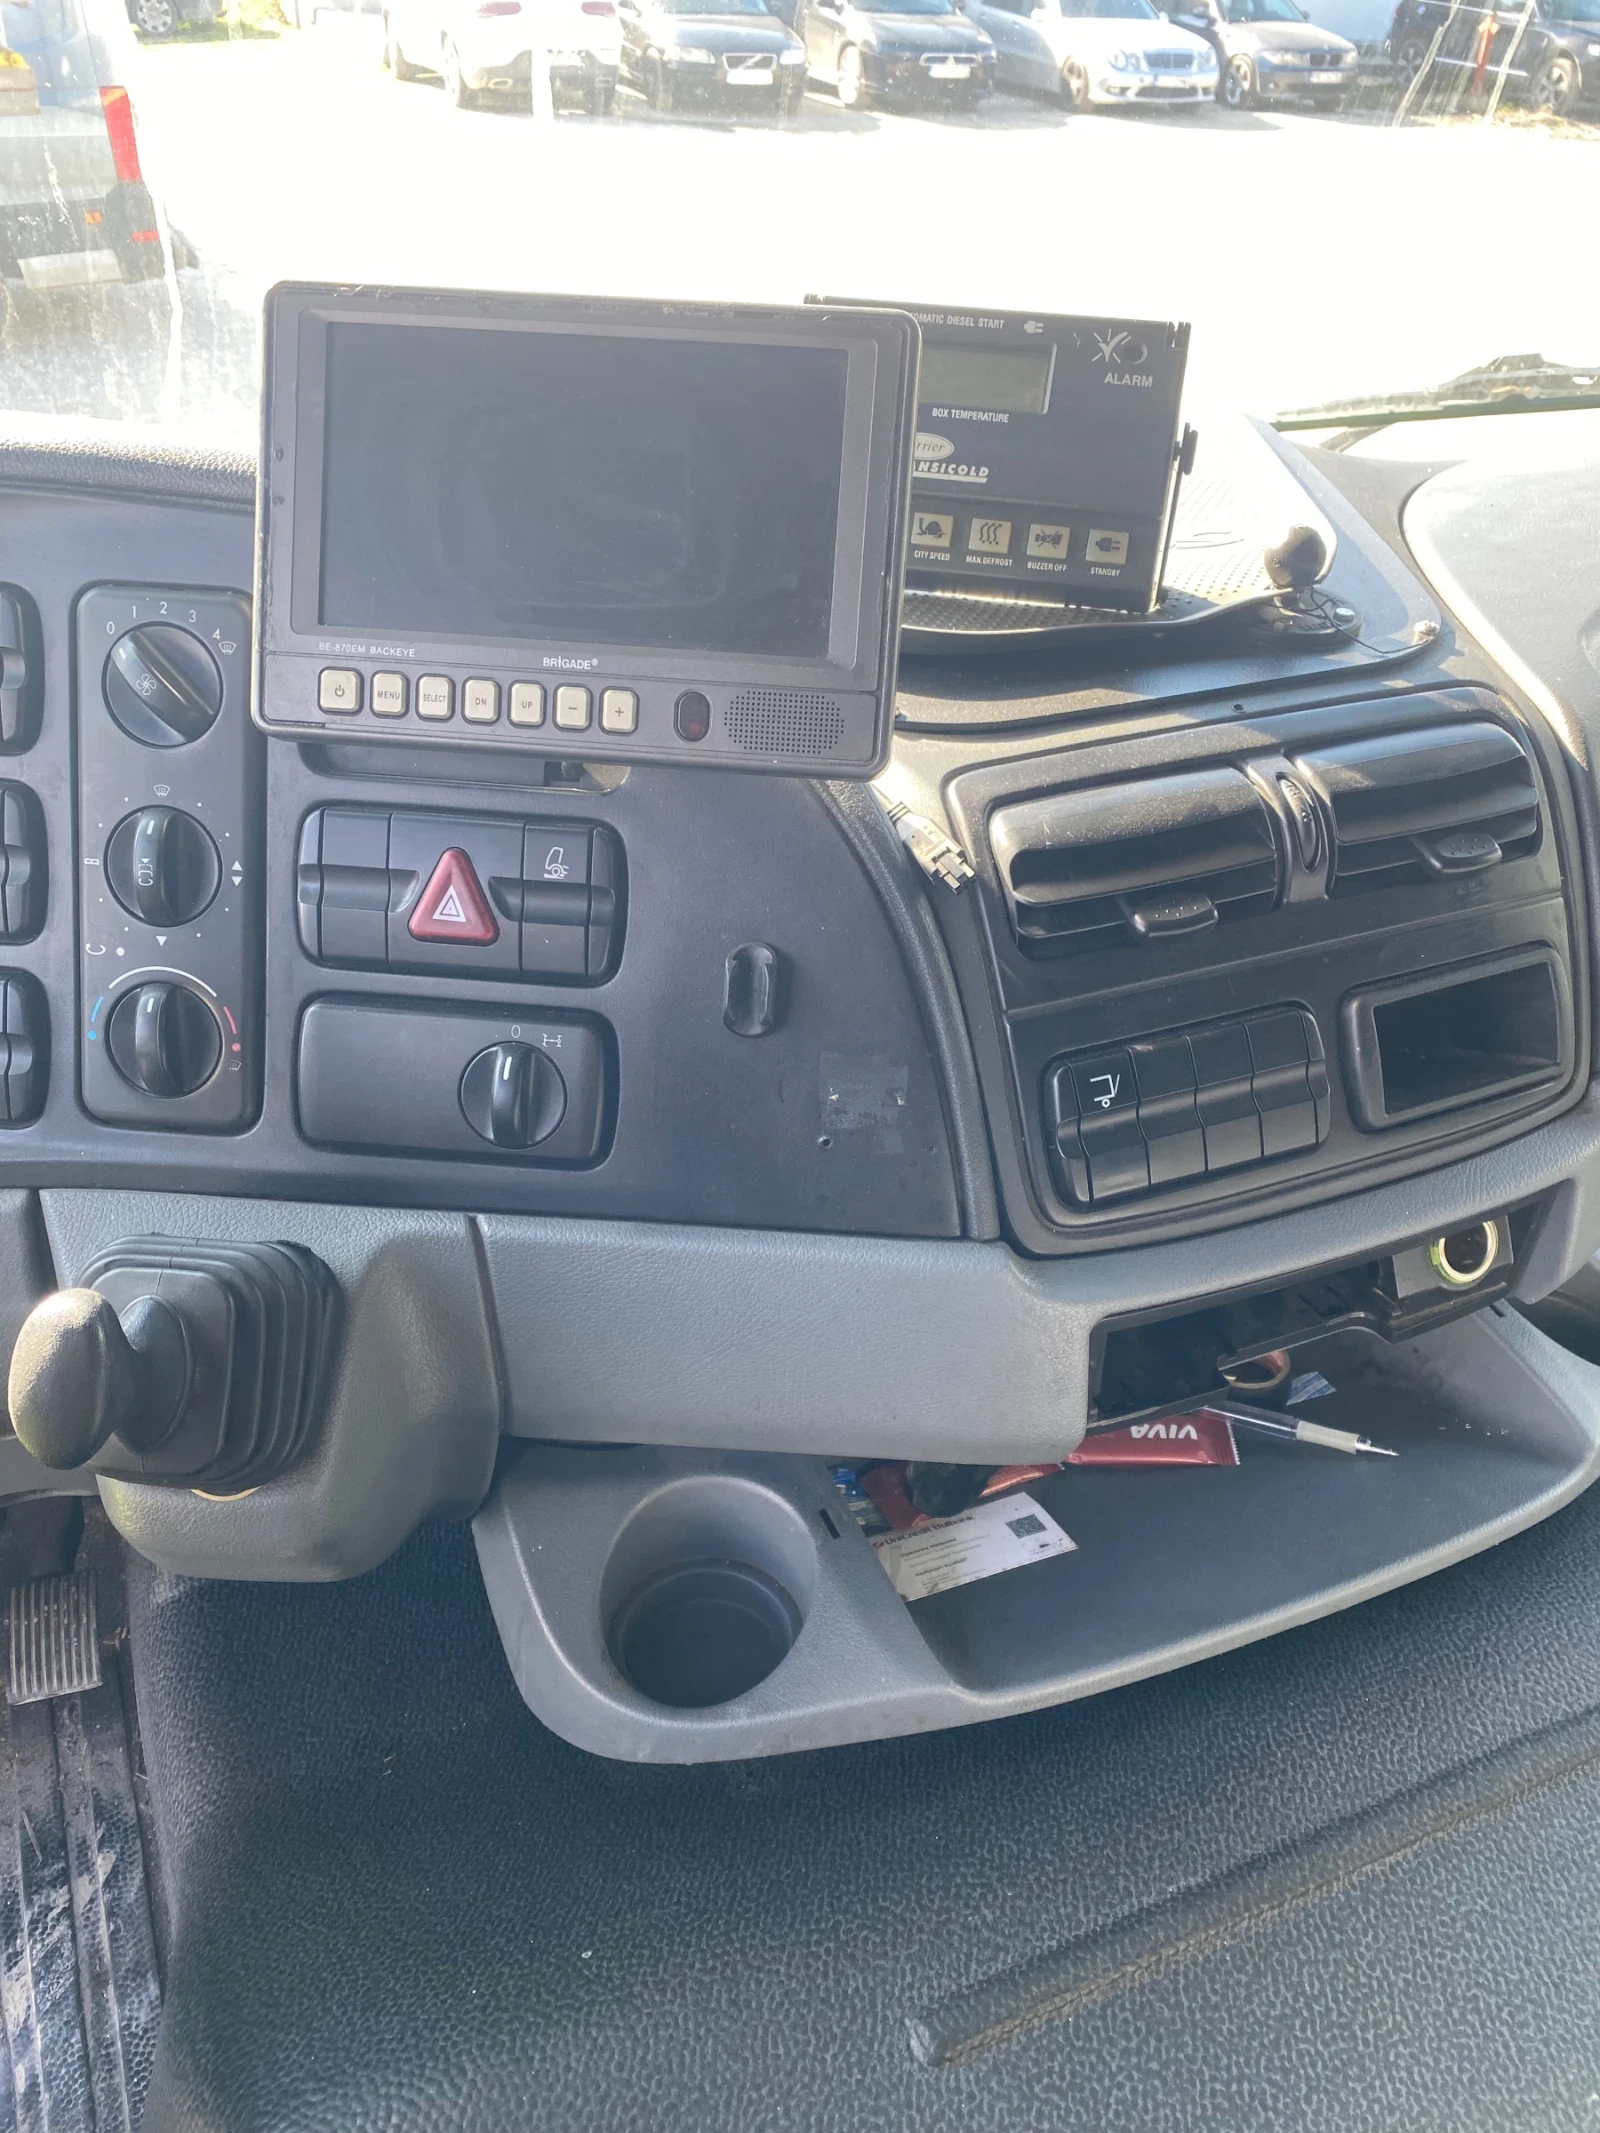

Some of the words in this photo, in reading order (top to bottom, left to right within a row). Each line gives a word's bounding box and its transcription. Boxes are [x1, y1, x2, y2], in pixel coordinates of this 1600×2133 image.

[947, 315, 975, 327] DIESEL
[978, 317, 1005, 329] START
[1104, 372, 1153, 388] ALARM
[932, 408, 949, 419] BOX
[951, 409, 1010, 423] TEMPERATURE
[914, 550, 929, 559] CITY
[929, 551, 951, 561] SPEED
[1027, 561, 1053, 571] BUZZER
[1054, 563, 1068, 572] OFF
[1090, 566, 1121, 577] STANDBY
[106, 621, 115, 634] 0
[132, 606, 137, 618] 1
[159, 601, 168, 614] 2
[188, 609, 197, 623] 3
[212, 628, 221, 640] 4
[318, 642, 366, 653] BE-870EM
[370, 645, 416, 658] BACKEYE
[377, 690, 401, 700] MENU
[423, 693, 447, 704] SELECT
[475, 697, 487, 706] DN
[521, 700, 533, 709] UP
[1130, 1423, 1198, 1441] VIVA
[884, 1526, 932, 1545] UniCredit
